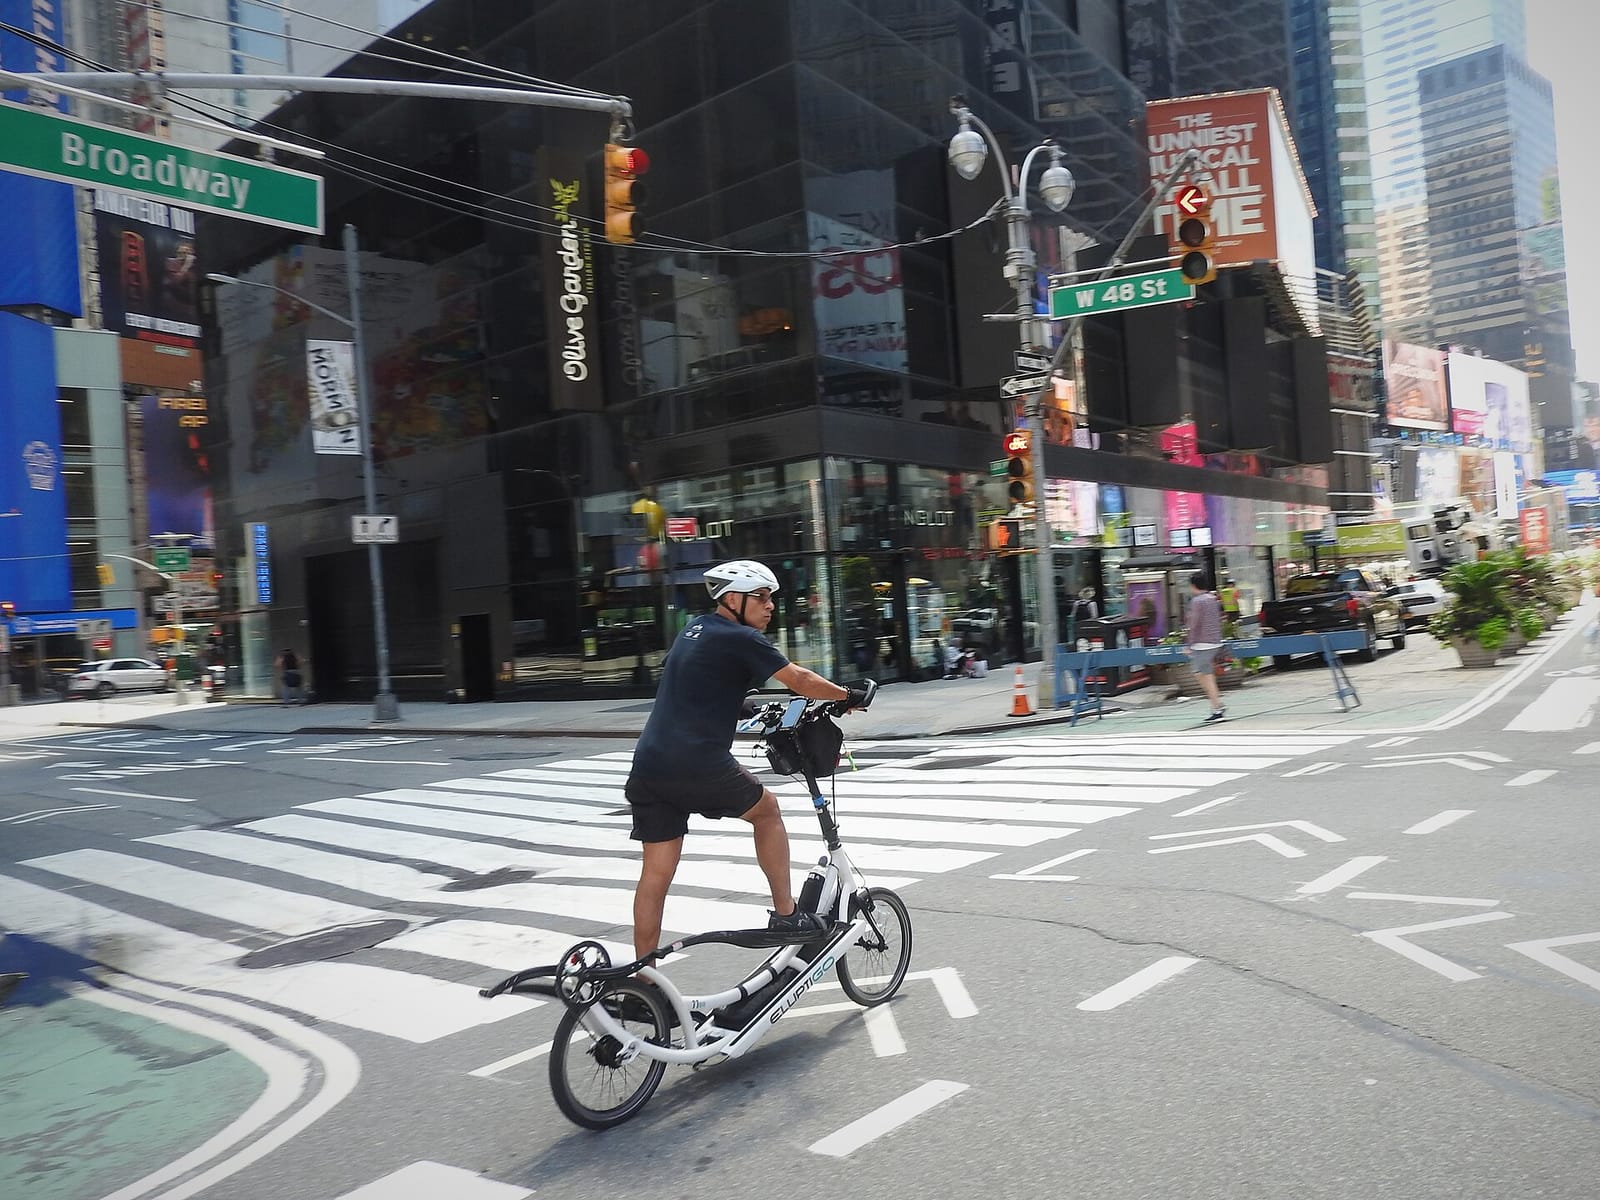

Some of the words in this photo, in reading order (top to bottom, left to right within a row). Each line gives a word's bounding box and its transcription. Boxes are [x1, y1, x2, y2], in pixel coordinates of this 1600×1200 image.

[1148, 123, 1258, 153] UNNIEST
[1175, 113, 1212, 128] THE
[61, 132, 251, 209] Broadway
[557, 220, 589, 313] Garden
[1075, 289, 1095, 308] W
[1101, 283, 1135, 303] 48
[1141, 279, 1167, 298] St
[562, 316, 589, 382] Olive
